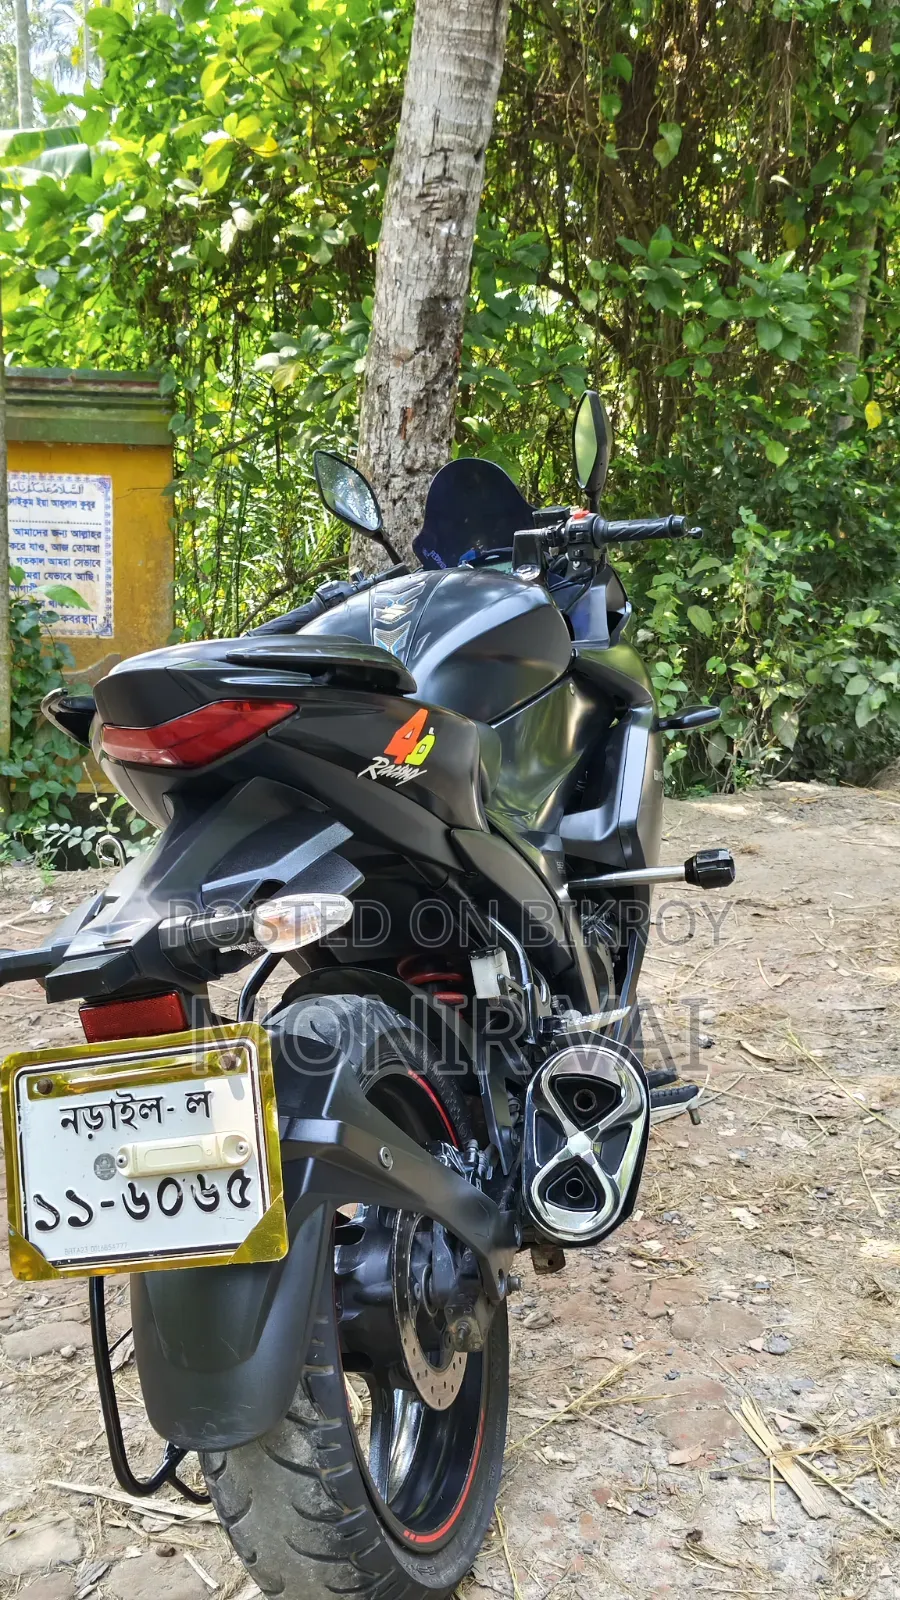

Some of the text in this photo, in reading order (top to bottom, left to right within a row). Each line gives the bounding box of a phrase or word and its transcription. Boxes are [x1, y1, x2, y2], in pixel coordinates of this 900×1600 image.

[13, 528, 48, 537] আমাদের
[51, 529, 68, 539] জন্য
[51, 543, 69, 553] আজ
[72, 544, 100, 554] তোমরা
[16, 557, 45, 567] গতকাল
[48, 558, 71, 567] আমরা
[44, 571, 72, 581] যেভাবে
[33, 1168, 252, 1232] ১১-৬০৬৫
